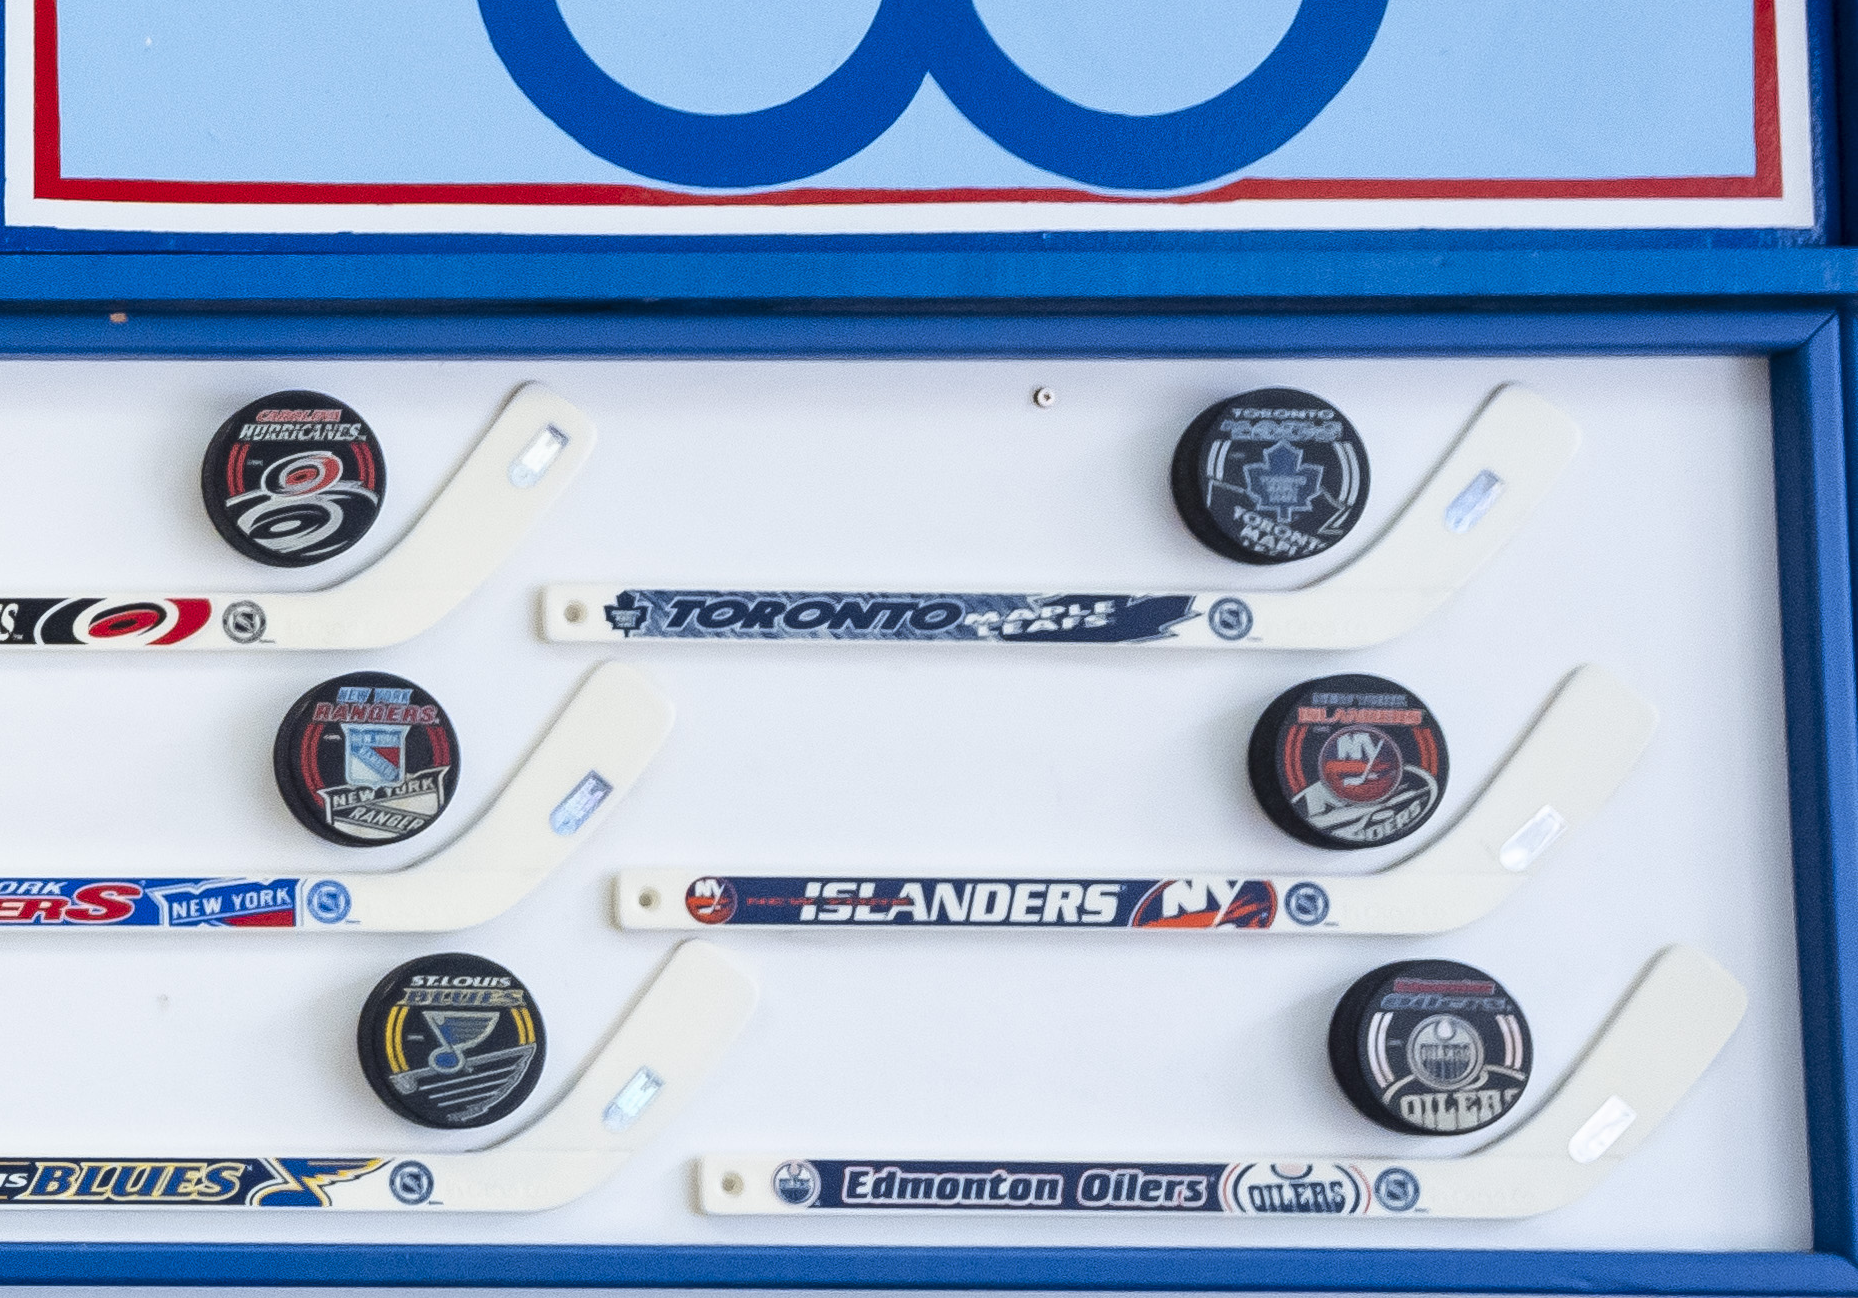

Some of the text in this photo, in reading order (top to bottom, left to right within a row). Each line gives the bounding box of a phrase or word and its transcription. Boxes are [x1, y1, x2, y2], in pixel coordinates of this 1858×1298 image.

[238, 423, 362, 441] HURRICANES
[665, 599, 966, 632] TORONTO
[337, 687, 413, 704] NEW YORK
[313, 702, 438, 724] RANGERS
[334, 787, 376, 806] NEW
[171, 887, 293, 920] NEW YORK
[799, 882, 1123, 922] ISLANDERS
[15, 1162, 246, 1201] BLUES
[842, 1166, 1207, 1206] Edmonton Oilers
[1247, 1181, 1347, 1213] OILERS
